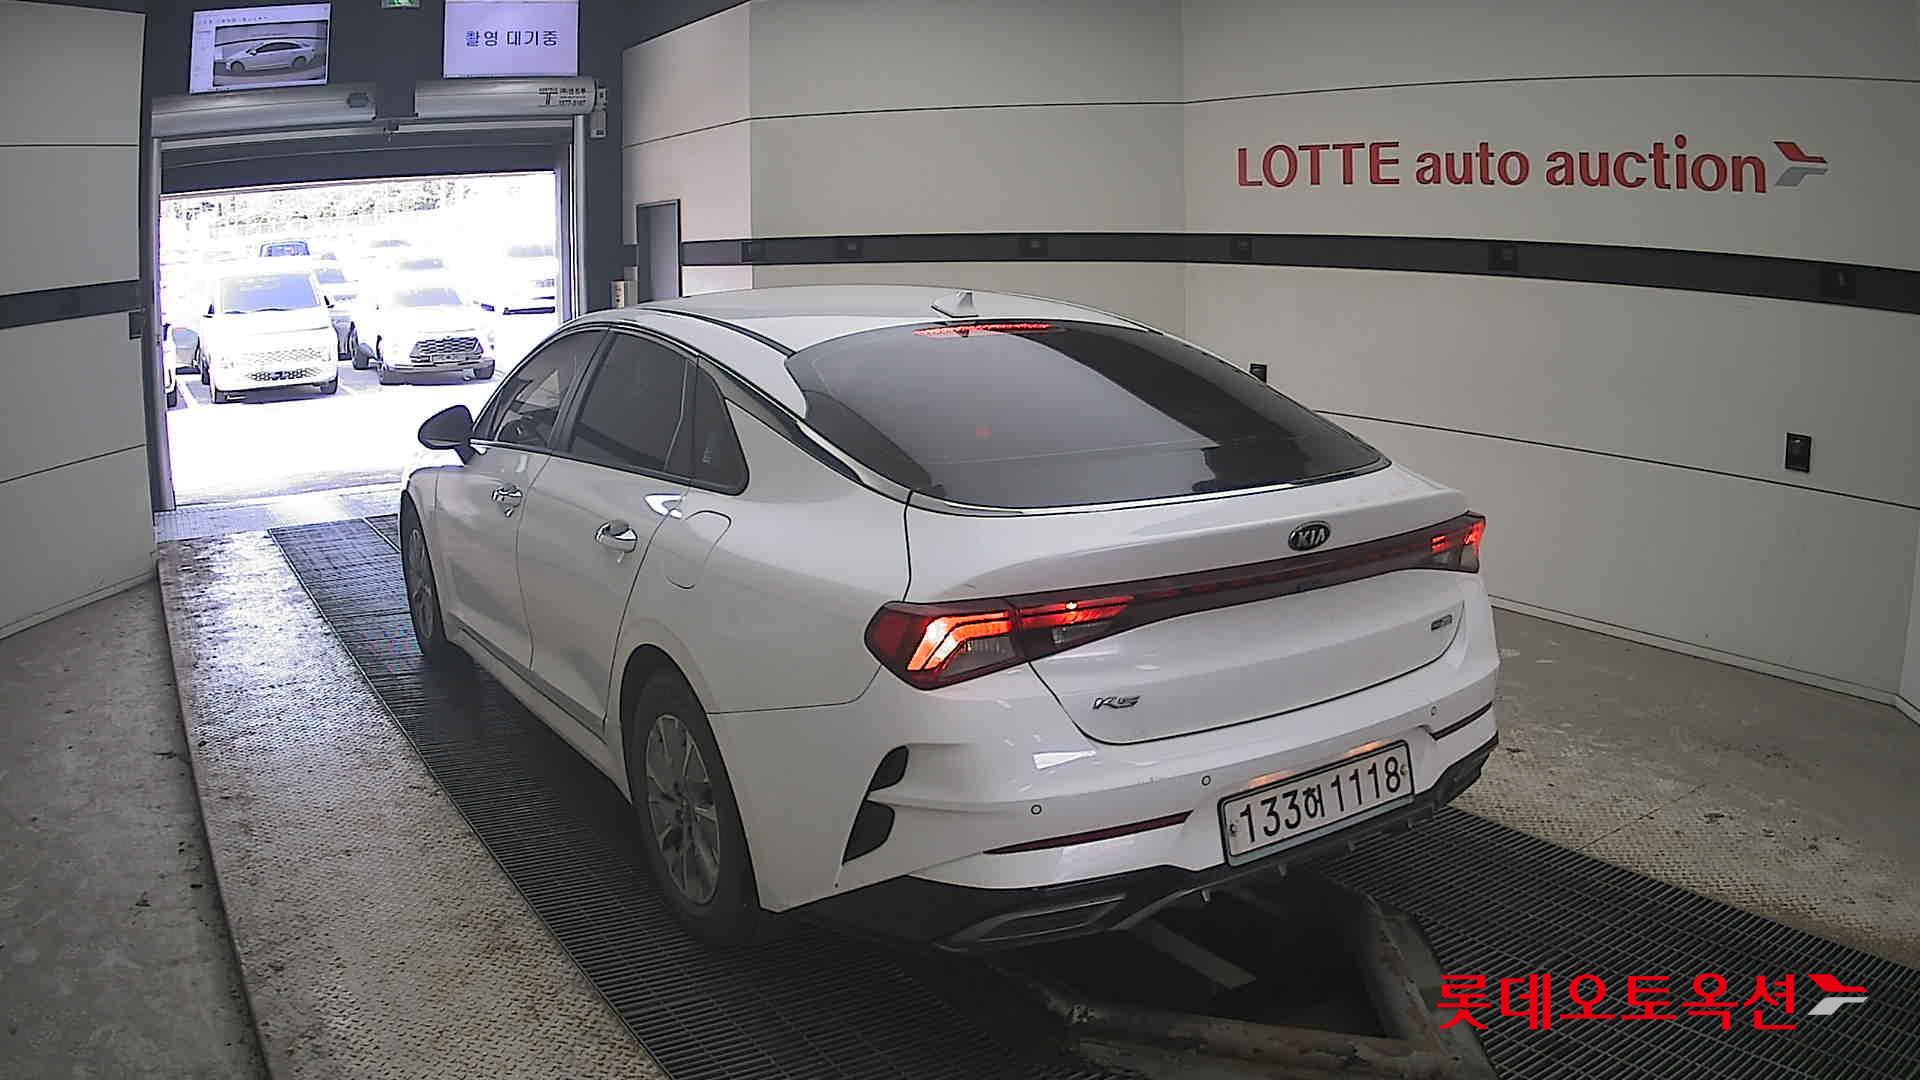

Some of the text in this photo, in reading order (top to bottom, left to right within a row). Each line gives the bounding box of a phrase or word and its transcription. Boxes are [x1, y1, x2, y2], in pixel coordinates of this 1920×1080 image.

[507, 31, 557, 46] 대기중
[1238, 135, 1767, 193] LOTTE auto auction
[1298, 527, 1325, 546] KIA
